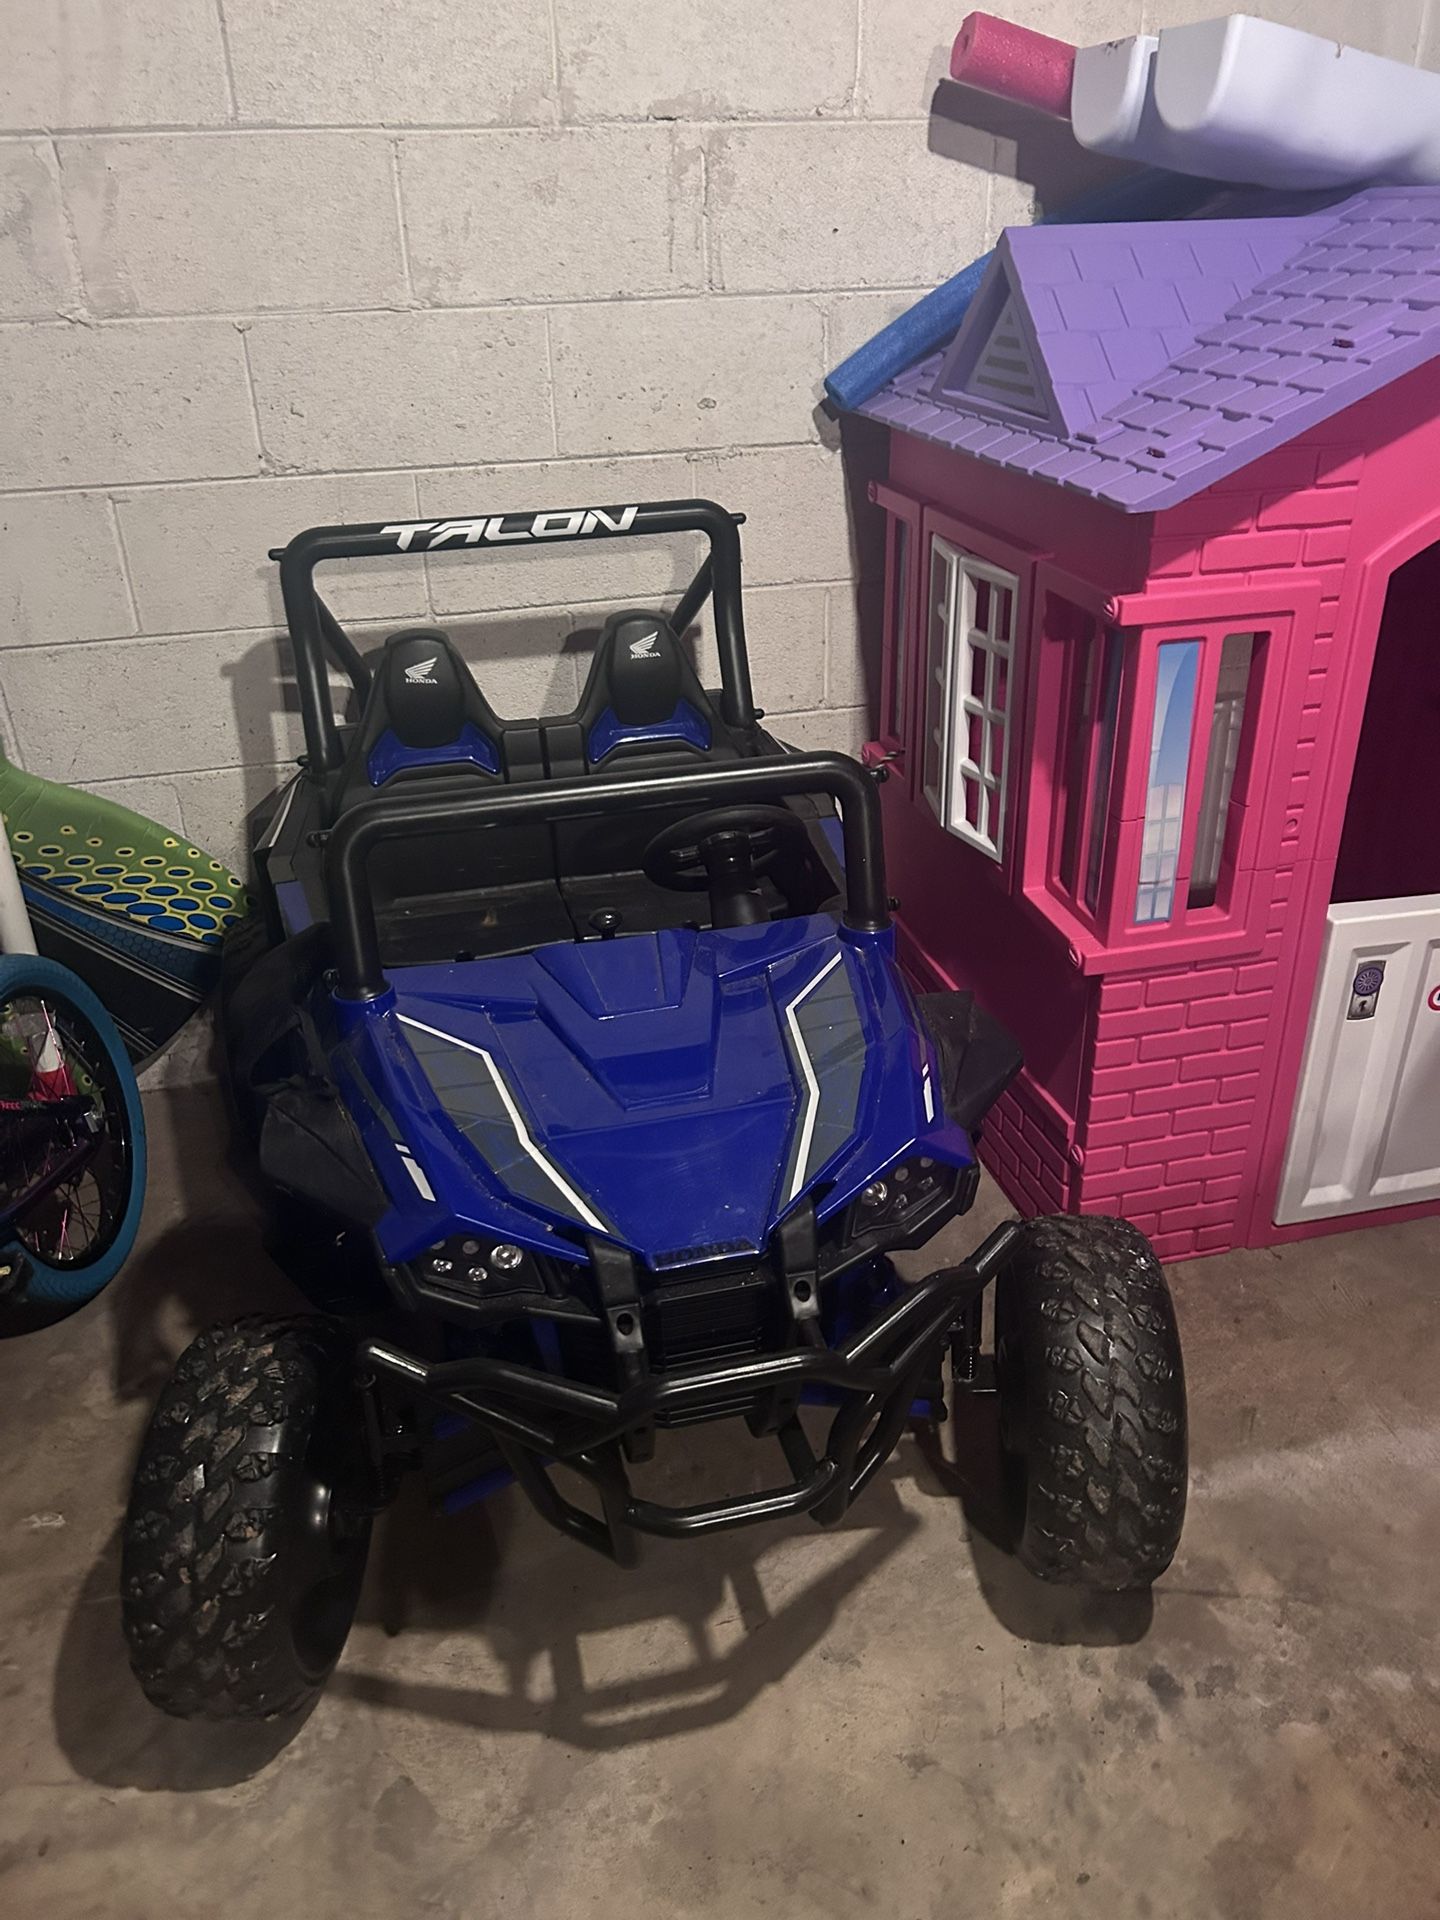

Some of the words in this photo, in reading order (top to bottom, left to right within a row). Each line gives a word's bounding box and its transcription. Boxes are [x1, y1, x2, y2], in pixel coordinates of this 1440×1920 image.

[380, 506, 639, 551] TALON
[630, 651, 661, 660] HONDA
[405, 677, 438, 685] HONDA
